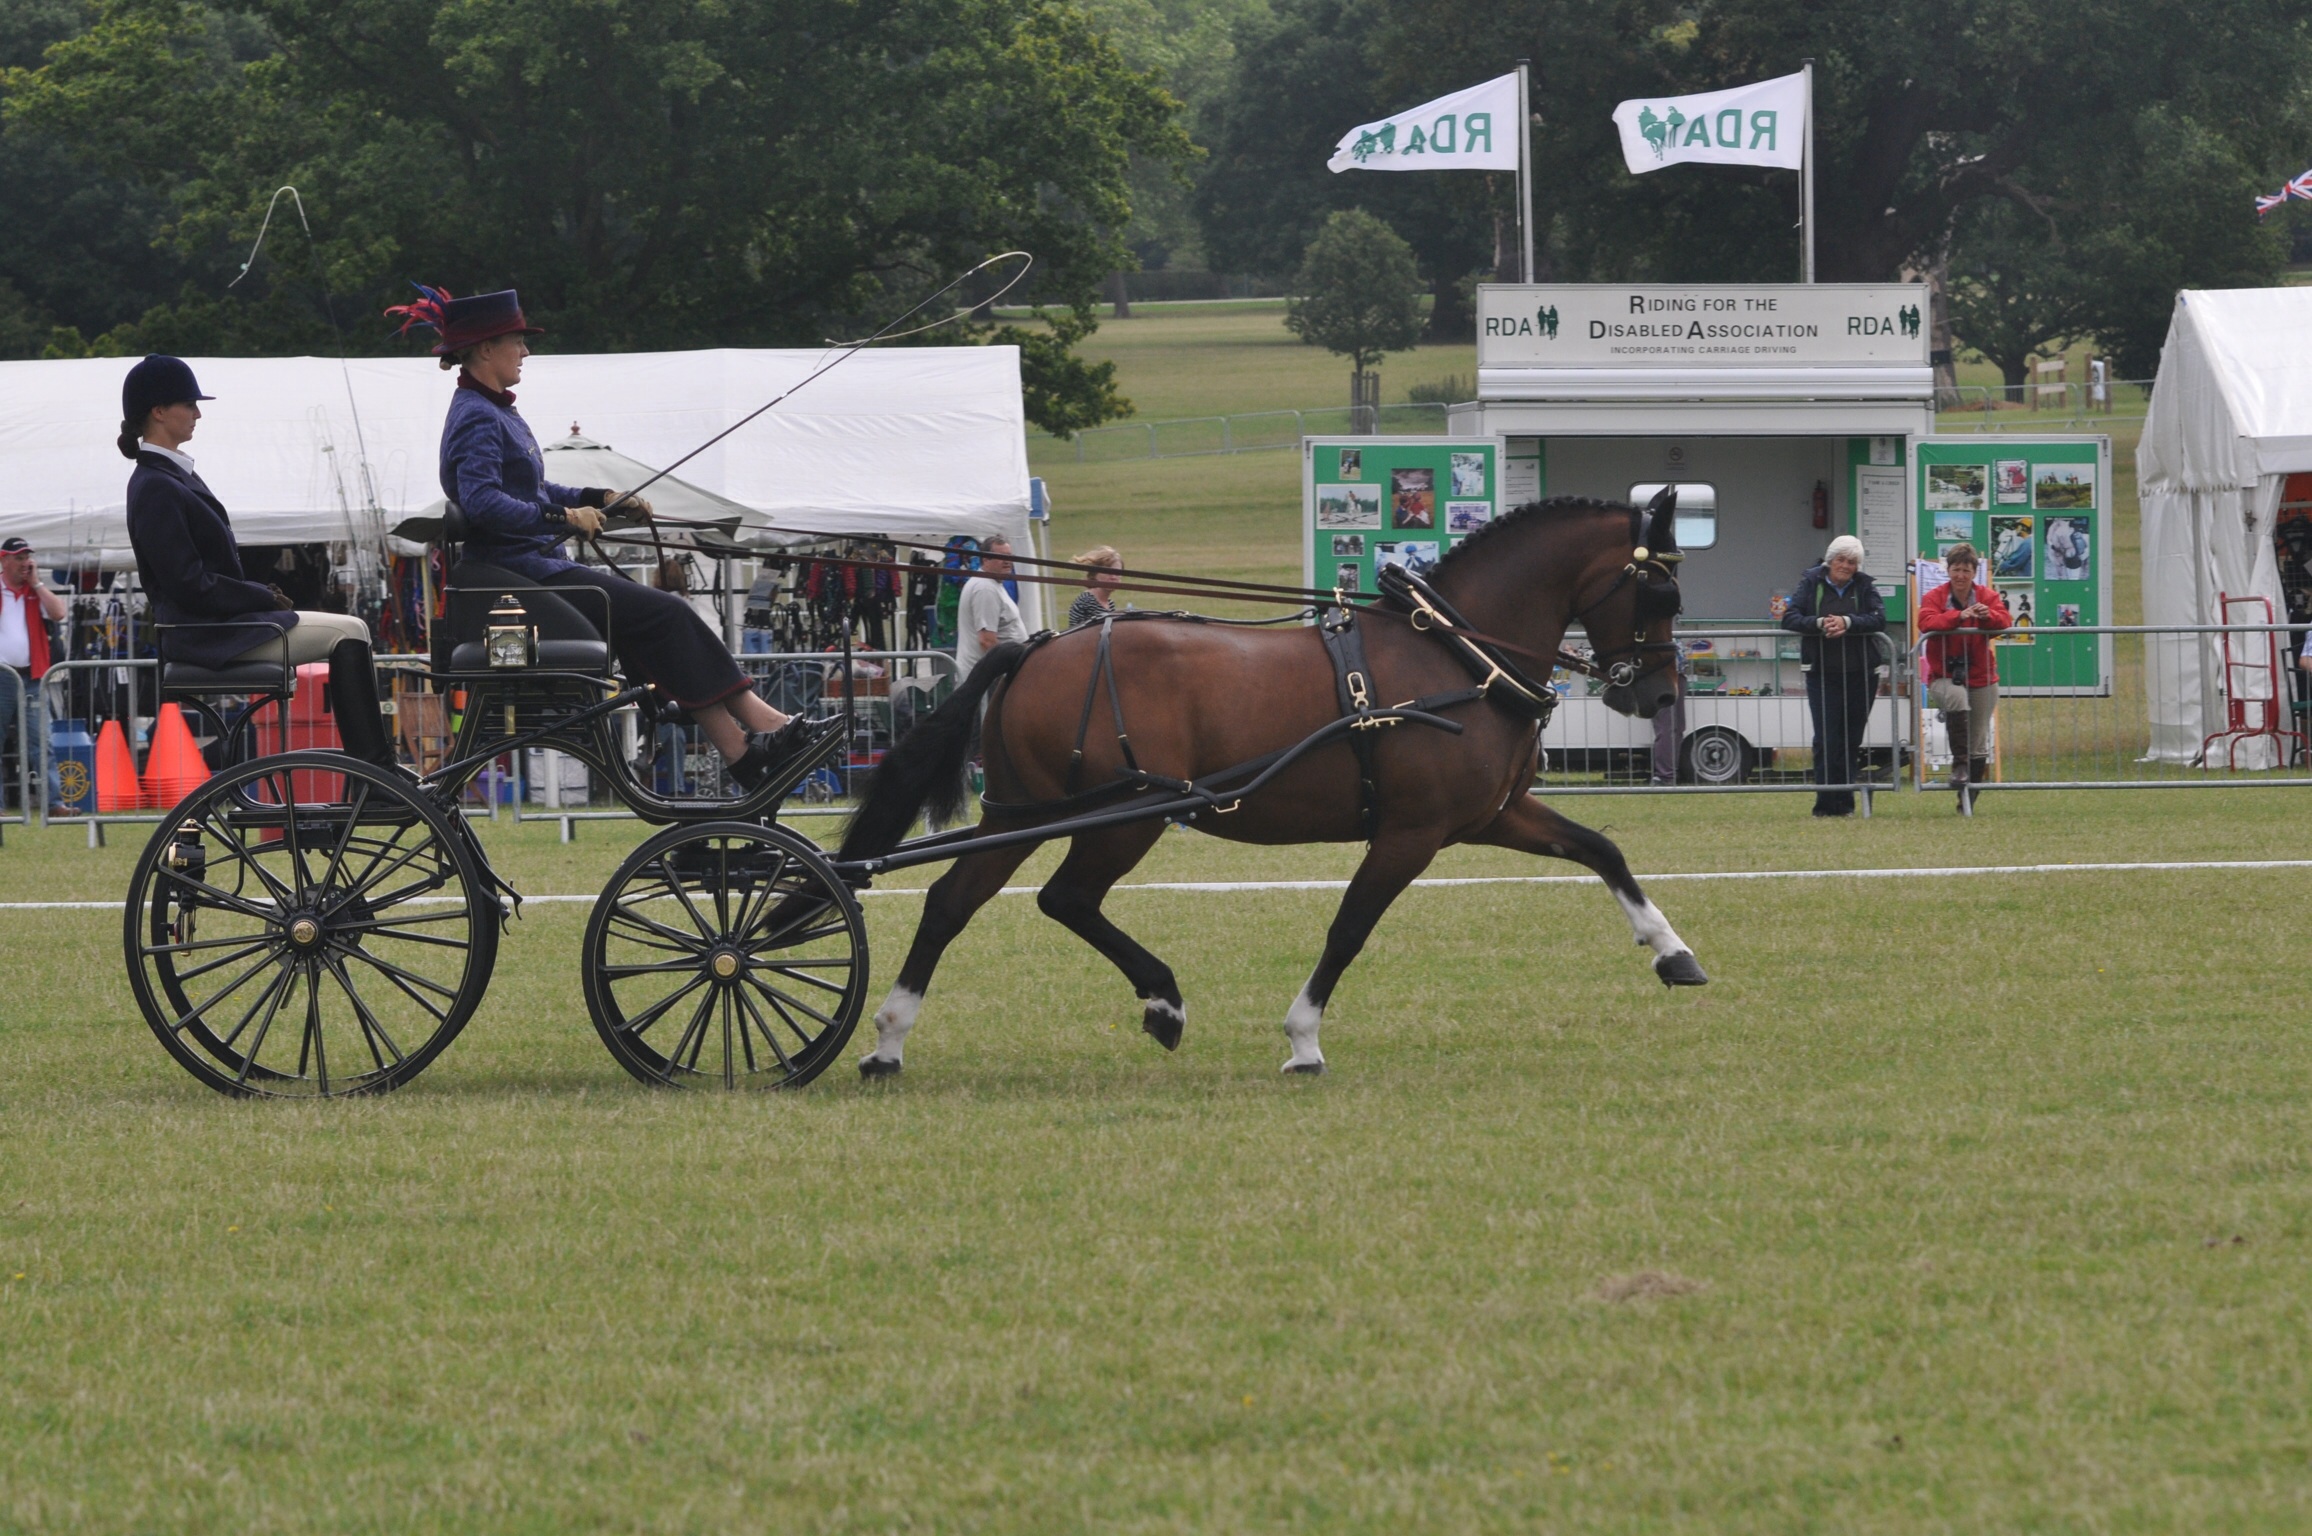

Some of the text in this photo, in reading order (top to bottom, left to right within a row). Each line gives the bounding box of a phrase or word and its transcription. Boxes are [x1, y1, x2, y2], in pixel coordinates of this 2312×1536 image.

[1630, 295, 1778, 314] RIDING FOR THE
[1485, 317, 1533, 336] RDA
[1589, 320, 1818, 339] DISABLED ASSOCIATION
[1847, 316, 1895, 336] RDA
[1610, 346, 1797, 354] INCORPORATING CARRIAGE DRIVING
